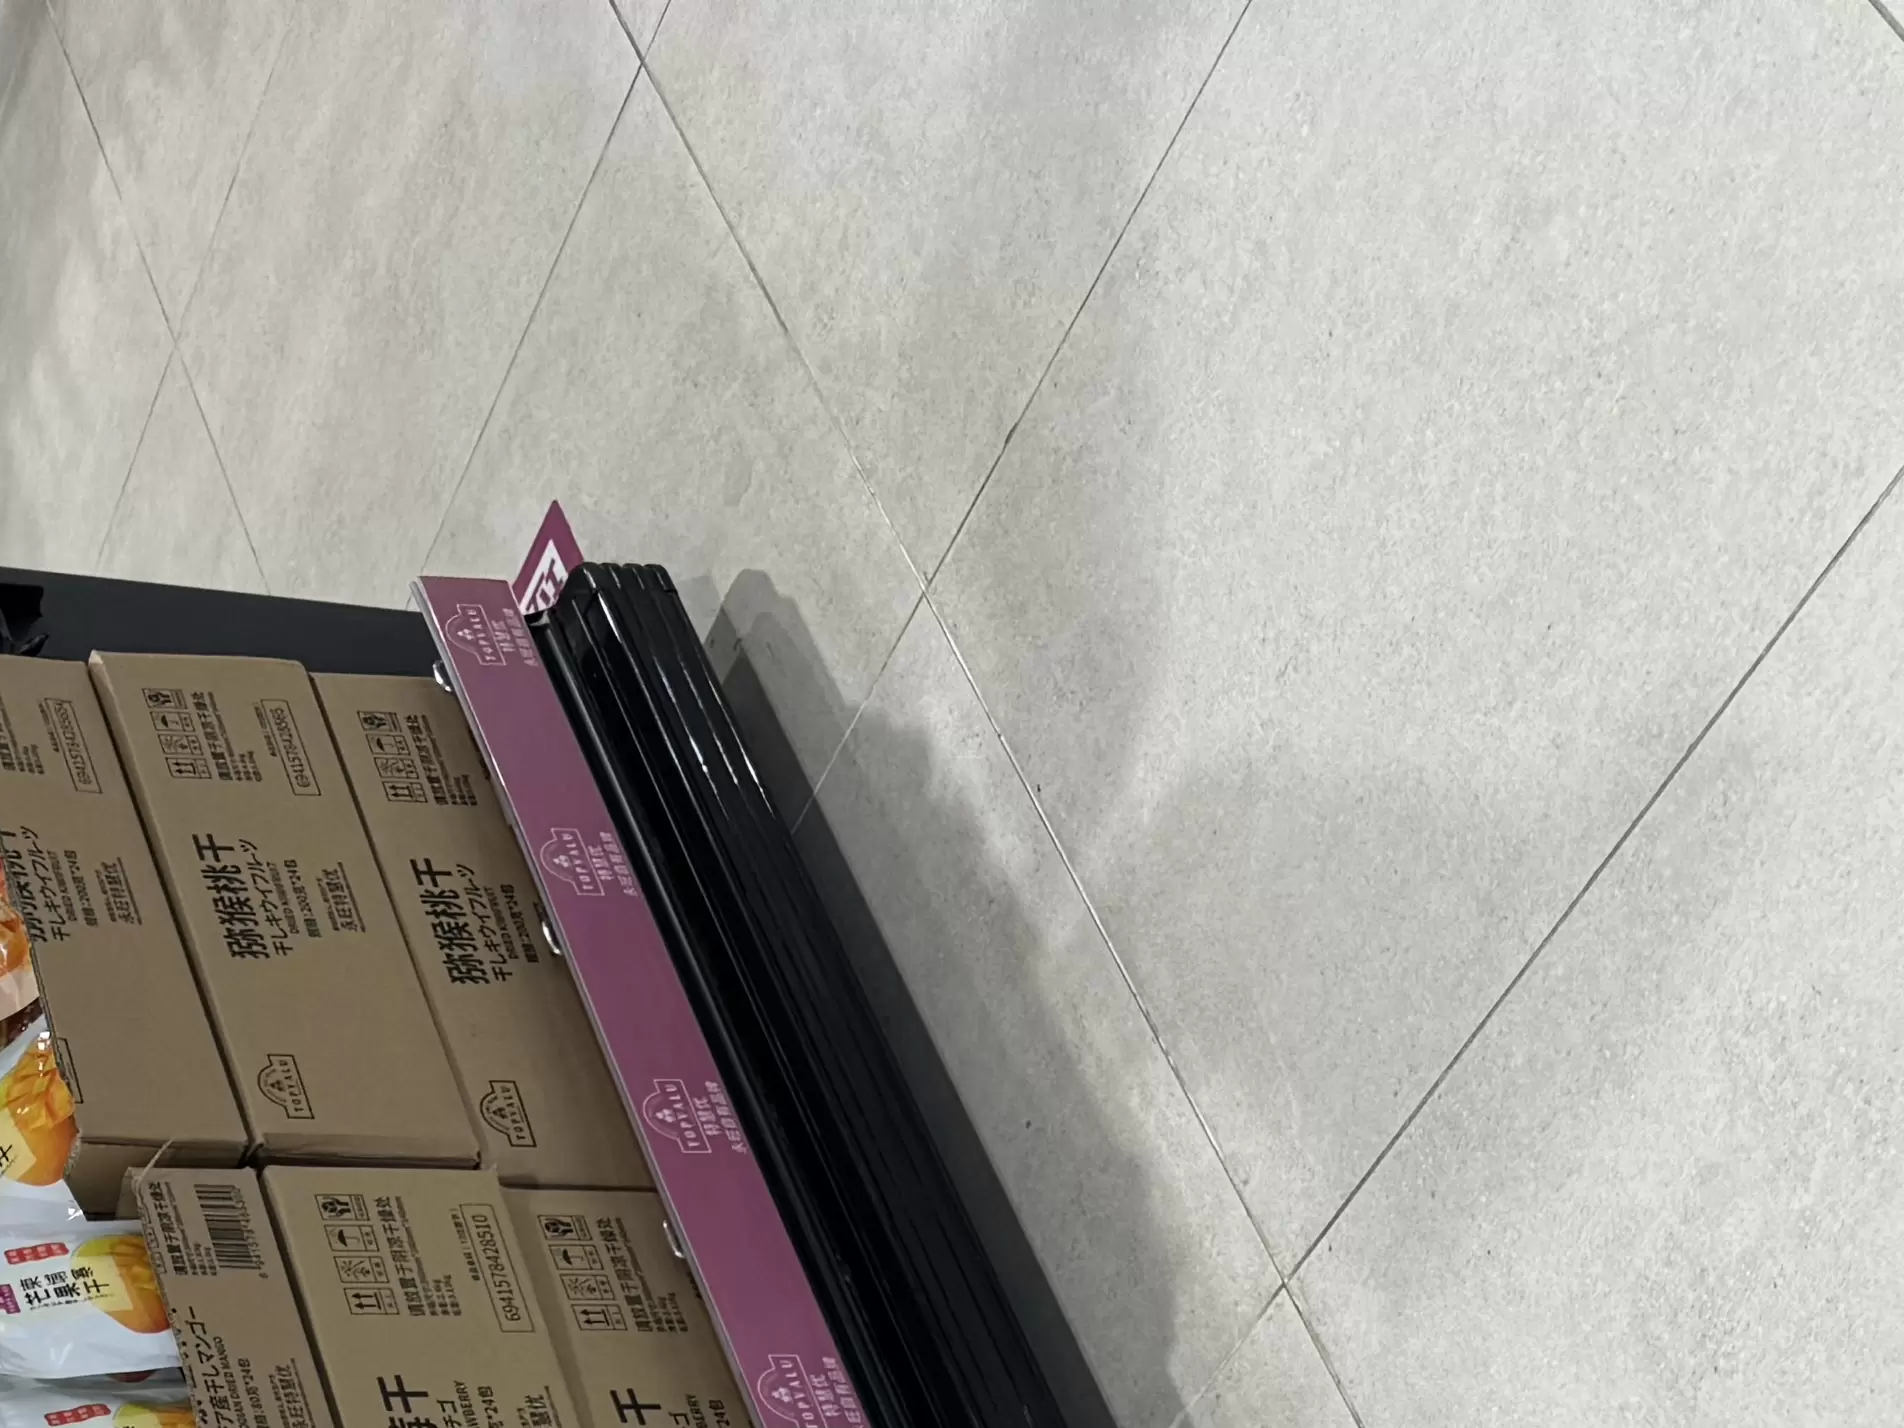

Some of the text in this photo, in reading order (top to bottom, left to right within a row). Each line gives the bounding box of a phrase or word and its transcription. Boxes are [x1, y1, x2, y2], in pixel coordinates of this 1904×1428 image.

[19, 824, 72, 943] 干しキウイフルーツ
[191, 833, 271, 960] 猕猴桃干
[237, 837, 294, 956] 干しキウイフルーツ
[409, 856, 493, 985] 猕猴桃干
[22, 1280, 112, 1309] 芒果干
[471, 1213, 522, 1322] 6941578428510
